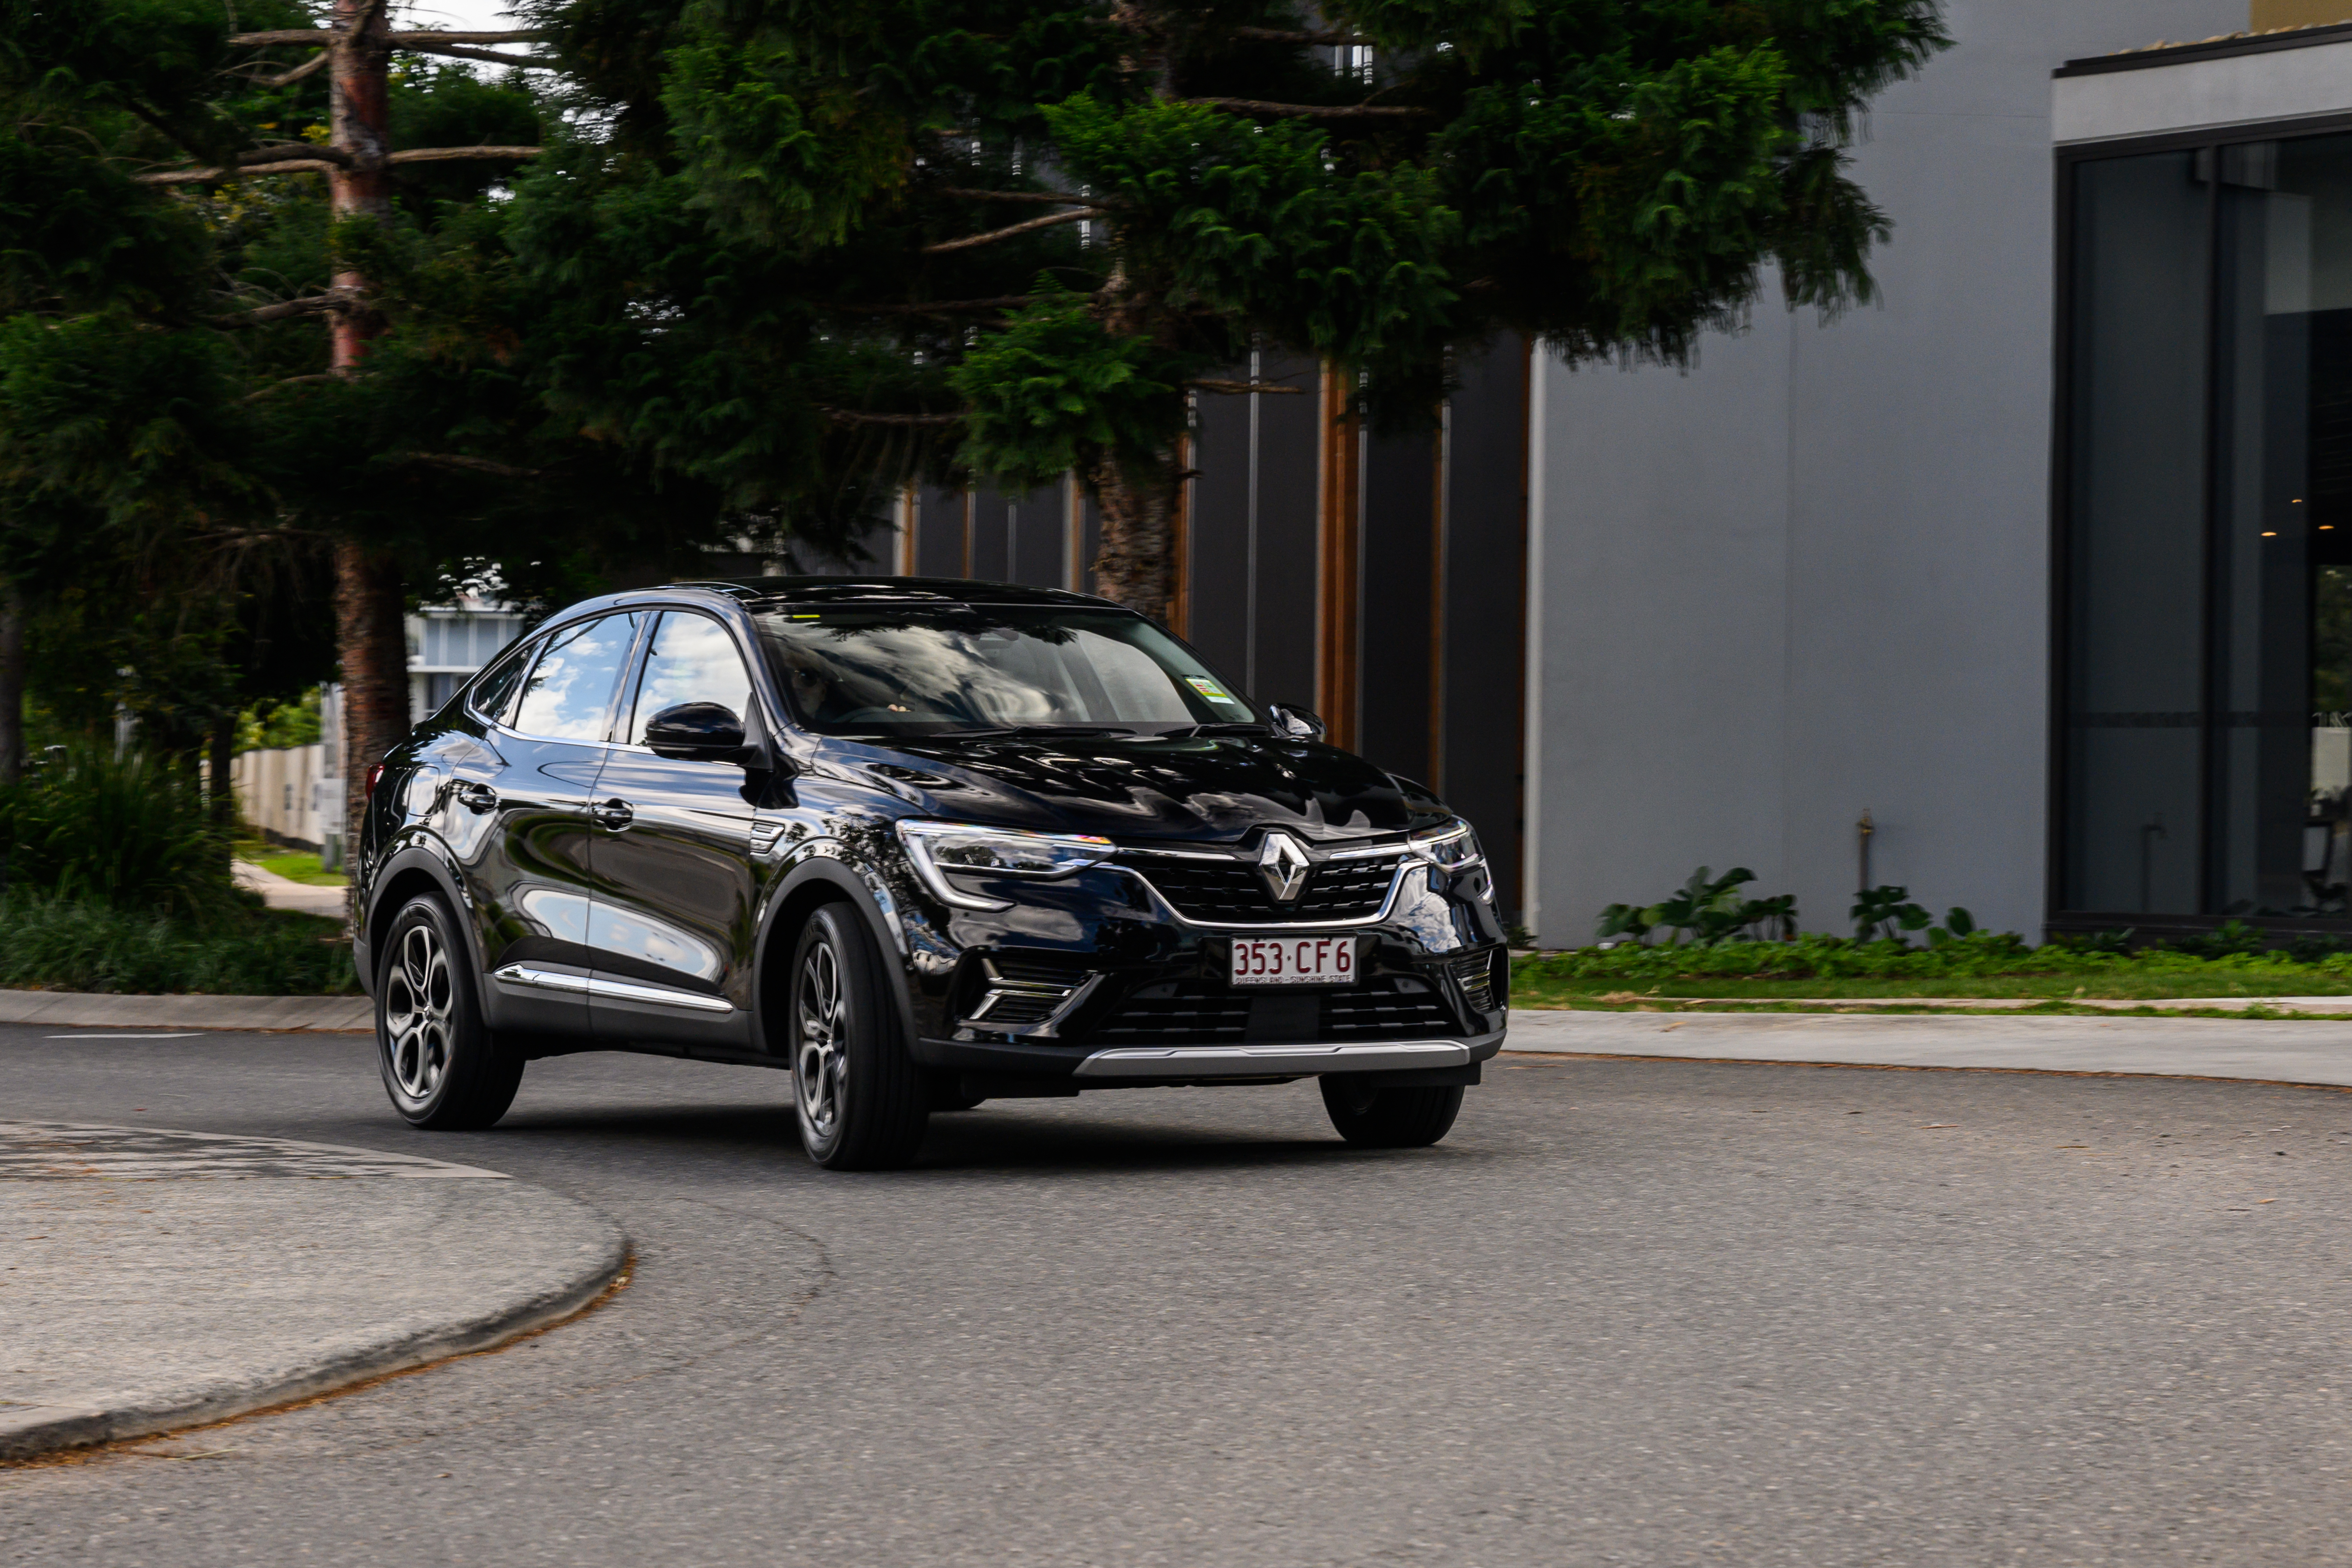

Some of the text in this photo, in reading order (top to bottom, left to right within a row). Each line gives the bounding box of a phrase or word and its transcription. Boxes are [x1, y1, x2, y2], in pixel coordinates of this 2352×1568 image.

[1235, 975, 1284, 984] QUEENSLAND
[1290, 974, 1327, 983] SUNSHINE
[1329, 974, 1351, 983] STATE
